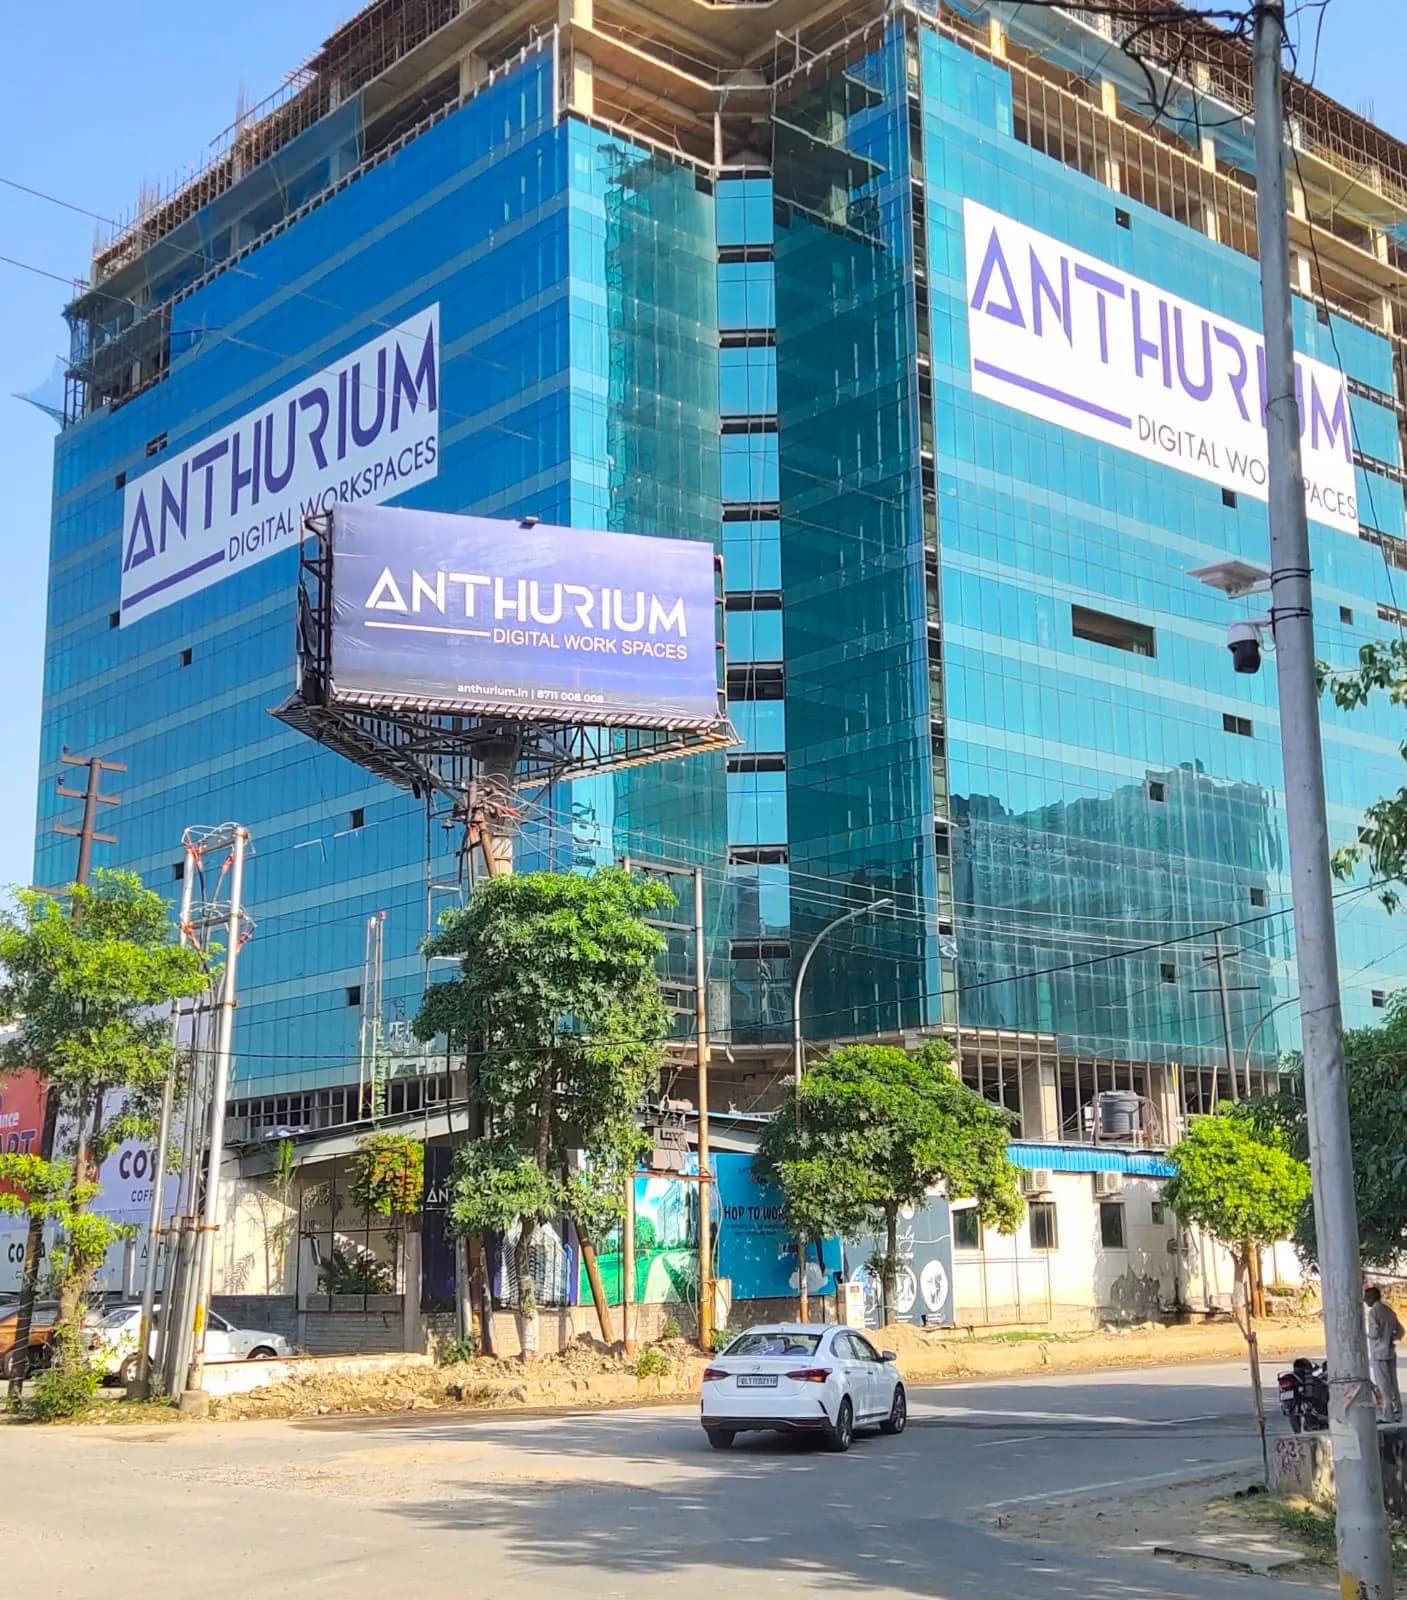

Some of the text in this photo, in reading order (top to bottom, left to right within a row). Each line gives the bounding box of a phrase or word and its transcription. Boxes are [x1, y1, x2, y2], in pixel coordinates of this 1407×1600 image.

[122, 319, 437, 573] ANTHURIUM
[1138, 414, 1357, 520] DIGITAL WOPACES
[228, 435, 437, 562] DIGITAL WORKSPACES
[365, 566, 687, 637] ANTHURIUM
[493, 628, 688, 660] DIGITAL WORK SPACES
[457, 684, 528, 698] anthurium.in
[537, 690, 558, 700] 8711
[724, 1206, 785, 1220] HOP TO WOR
